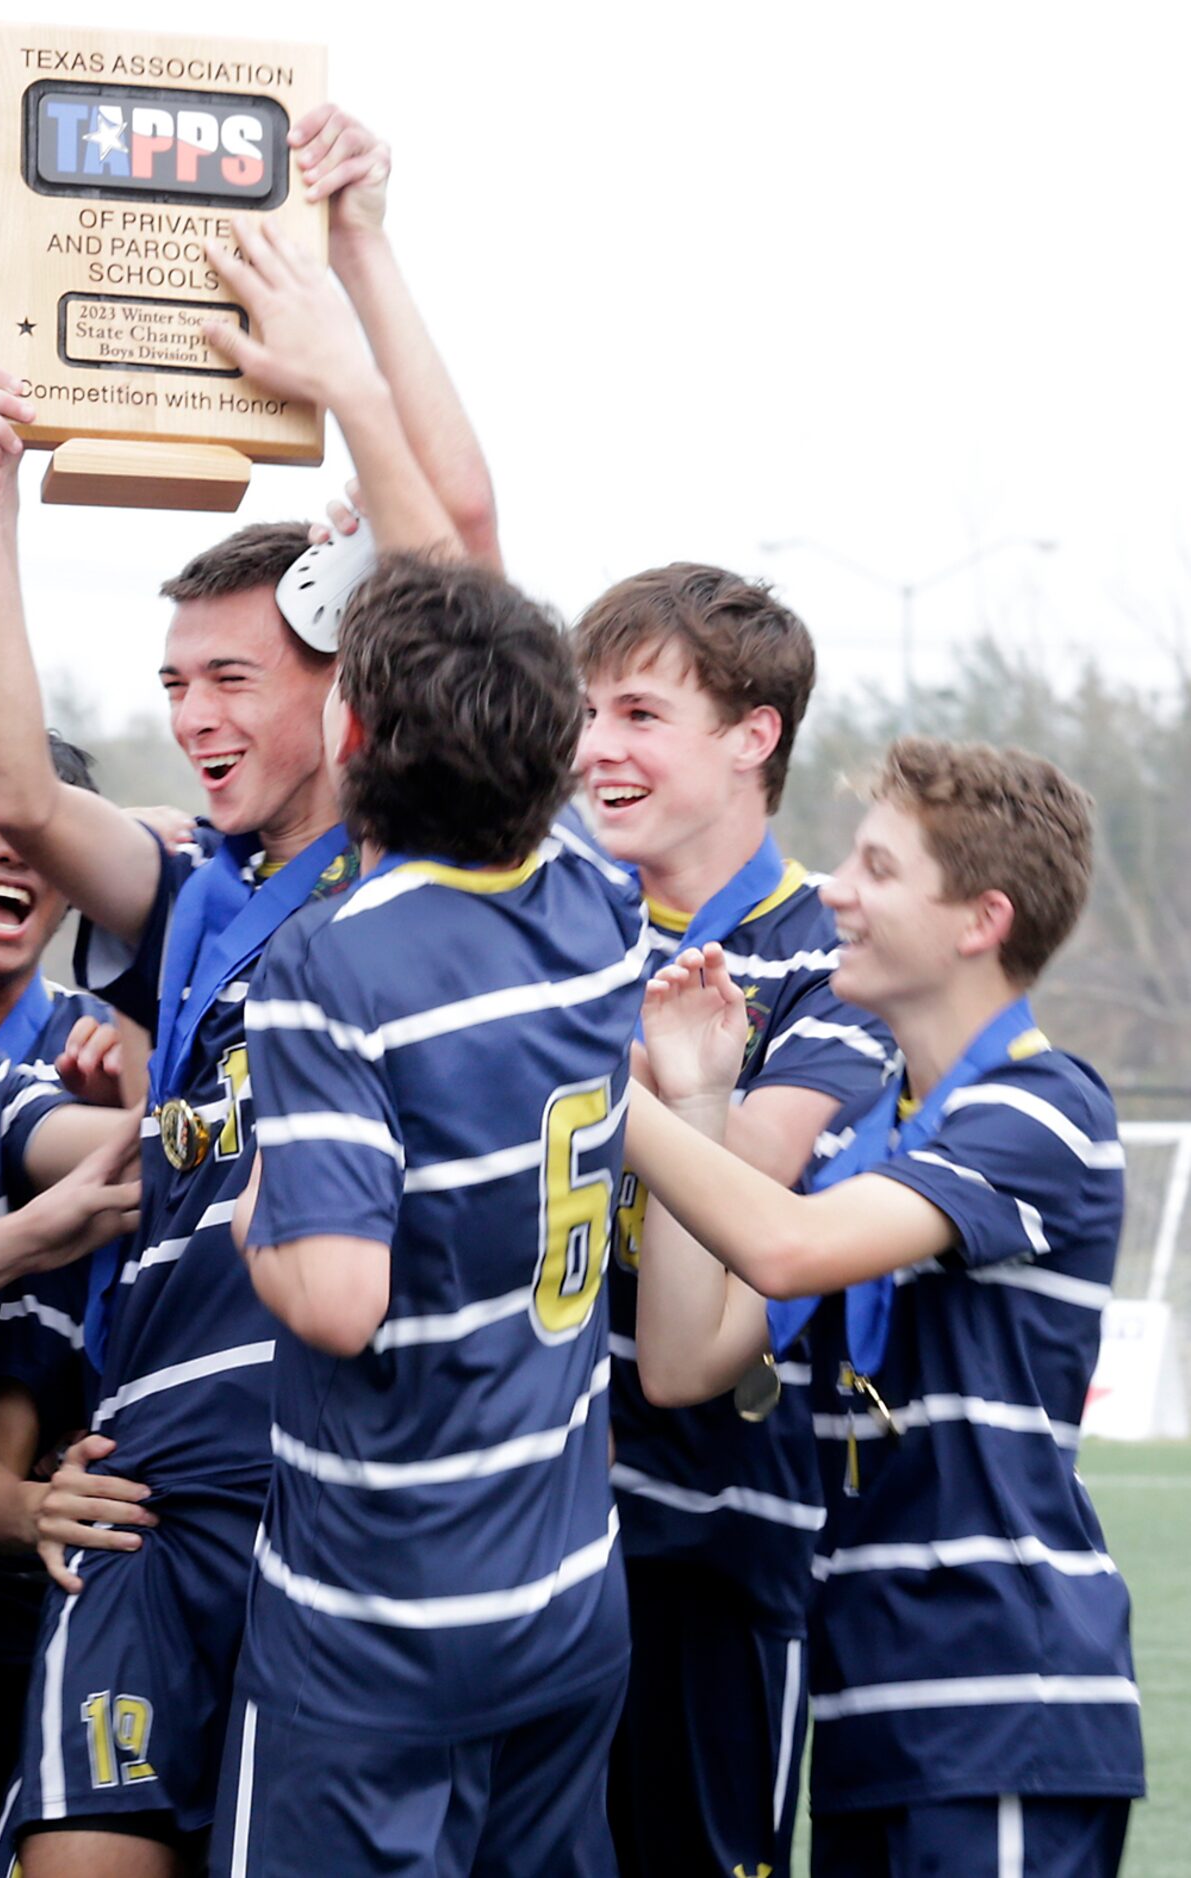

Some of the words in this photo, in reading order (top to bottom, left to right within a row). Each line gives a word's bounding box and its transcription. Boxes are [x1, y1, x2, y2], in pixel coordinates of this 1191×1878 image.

[20, 48, 105, 73] TEXAS
[111, 55, 294, 86] ASSOCIATION
[46, 102, 264, 187] TAPPS
[78, 208, 115, 230] OF
[122, 211, 231, 238] PRIVATE
[46, 233, 103, 255] AND
[88, 262, 220, 291] SCHOOLS
[79, 304, 116, 320] 2023
[122, 307, 174, 325] Winter
[75, 321, 124, 341] State
[129, 325, 208, 349] Champi
[99, 343, 135, 360] Boys
[138, 346, 198, 362] Division
[165, 390, 212, 410] with
[219, 393, 289, 416] Honor
[529, 1075, 614, 1347] 6
